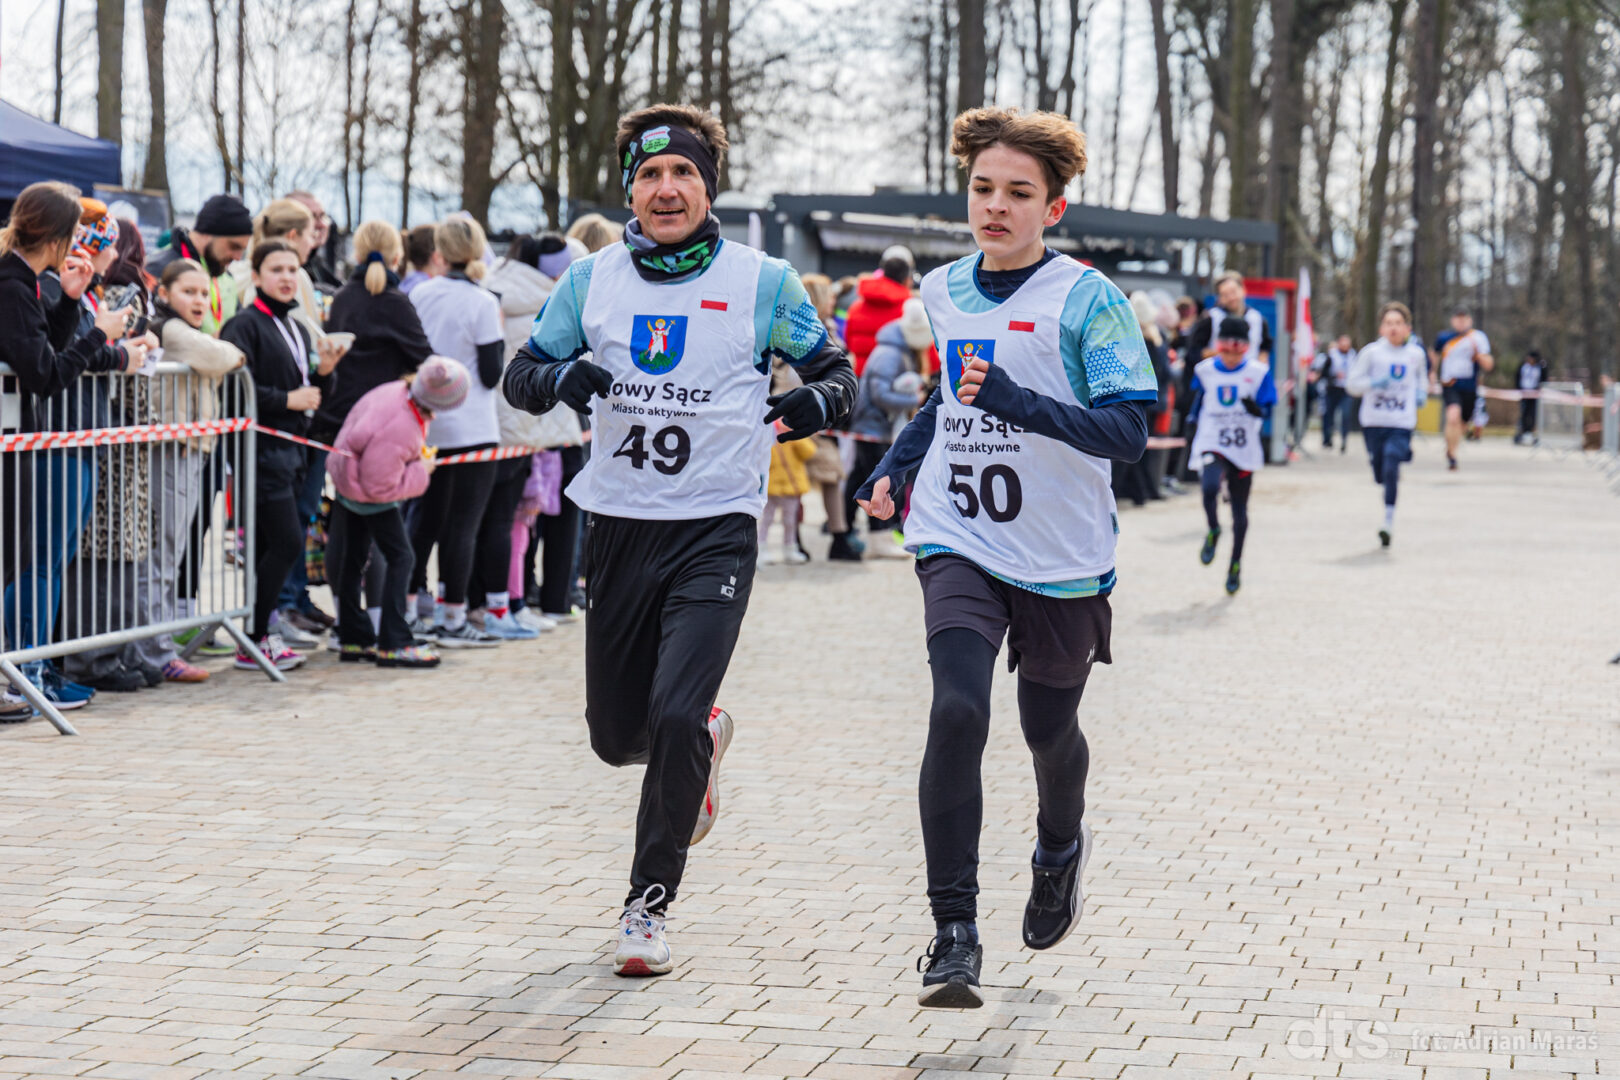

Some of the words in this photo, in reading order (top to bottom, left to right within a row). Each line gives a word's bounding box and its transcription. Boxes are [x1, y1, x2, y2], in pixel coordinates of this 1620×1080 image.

[609, 382, 656, 402] owy
[662, 382, 712, 406] Sącz
[612, 403, 645, 415] Miasto
[944, 416, 974, 438] owy
[980, 413, 1033, 438] Sąc
[1219, 427, 1247, 448] 58
[612, 425, 691, 475] 49
[968, 441, 1021, 455] aktywne
[948, 463, 1022, 522] 50
